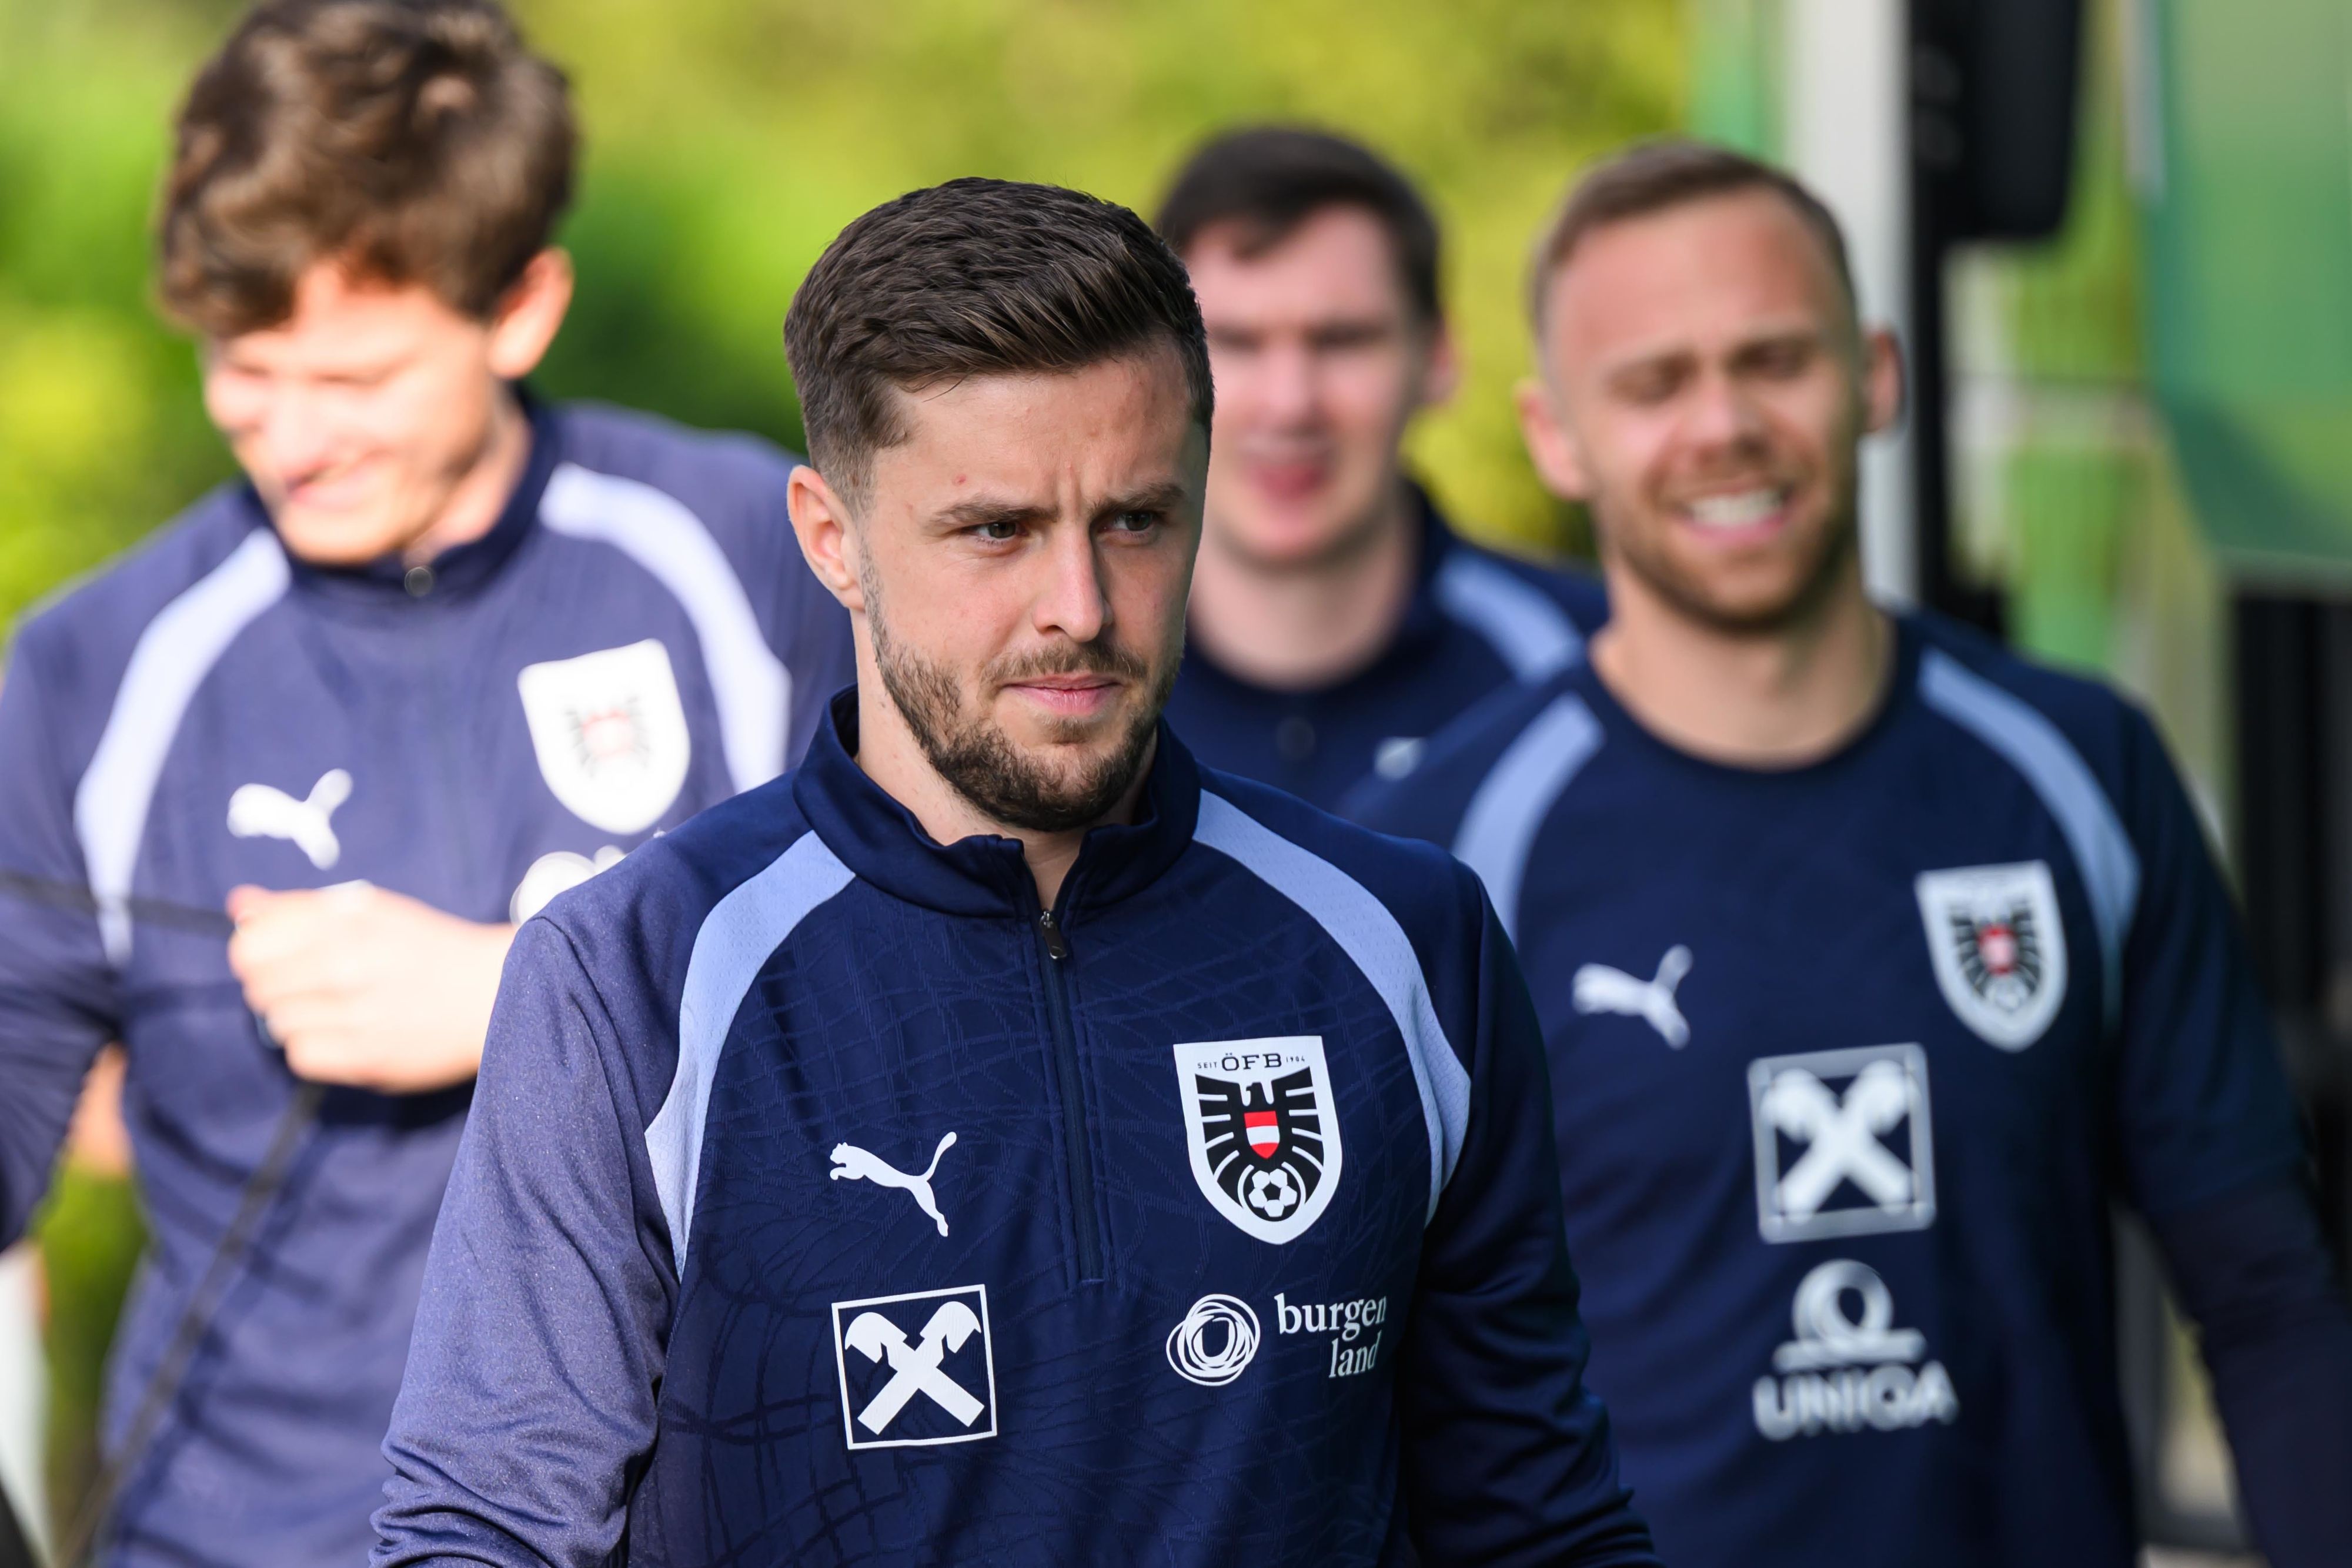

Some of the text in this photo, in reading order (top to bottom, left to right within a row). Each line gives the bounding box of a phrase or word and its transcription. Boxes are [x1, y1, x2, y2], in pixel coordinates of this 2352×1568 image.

[1197, 1061, 1217, 1069] SEIT
[1221, 1052, 1282, 1072] ÖFB
[1273, 1292, 1387, 1342] burgen
[1328, 1329, 1382, 1379] land
